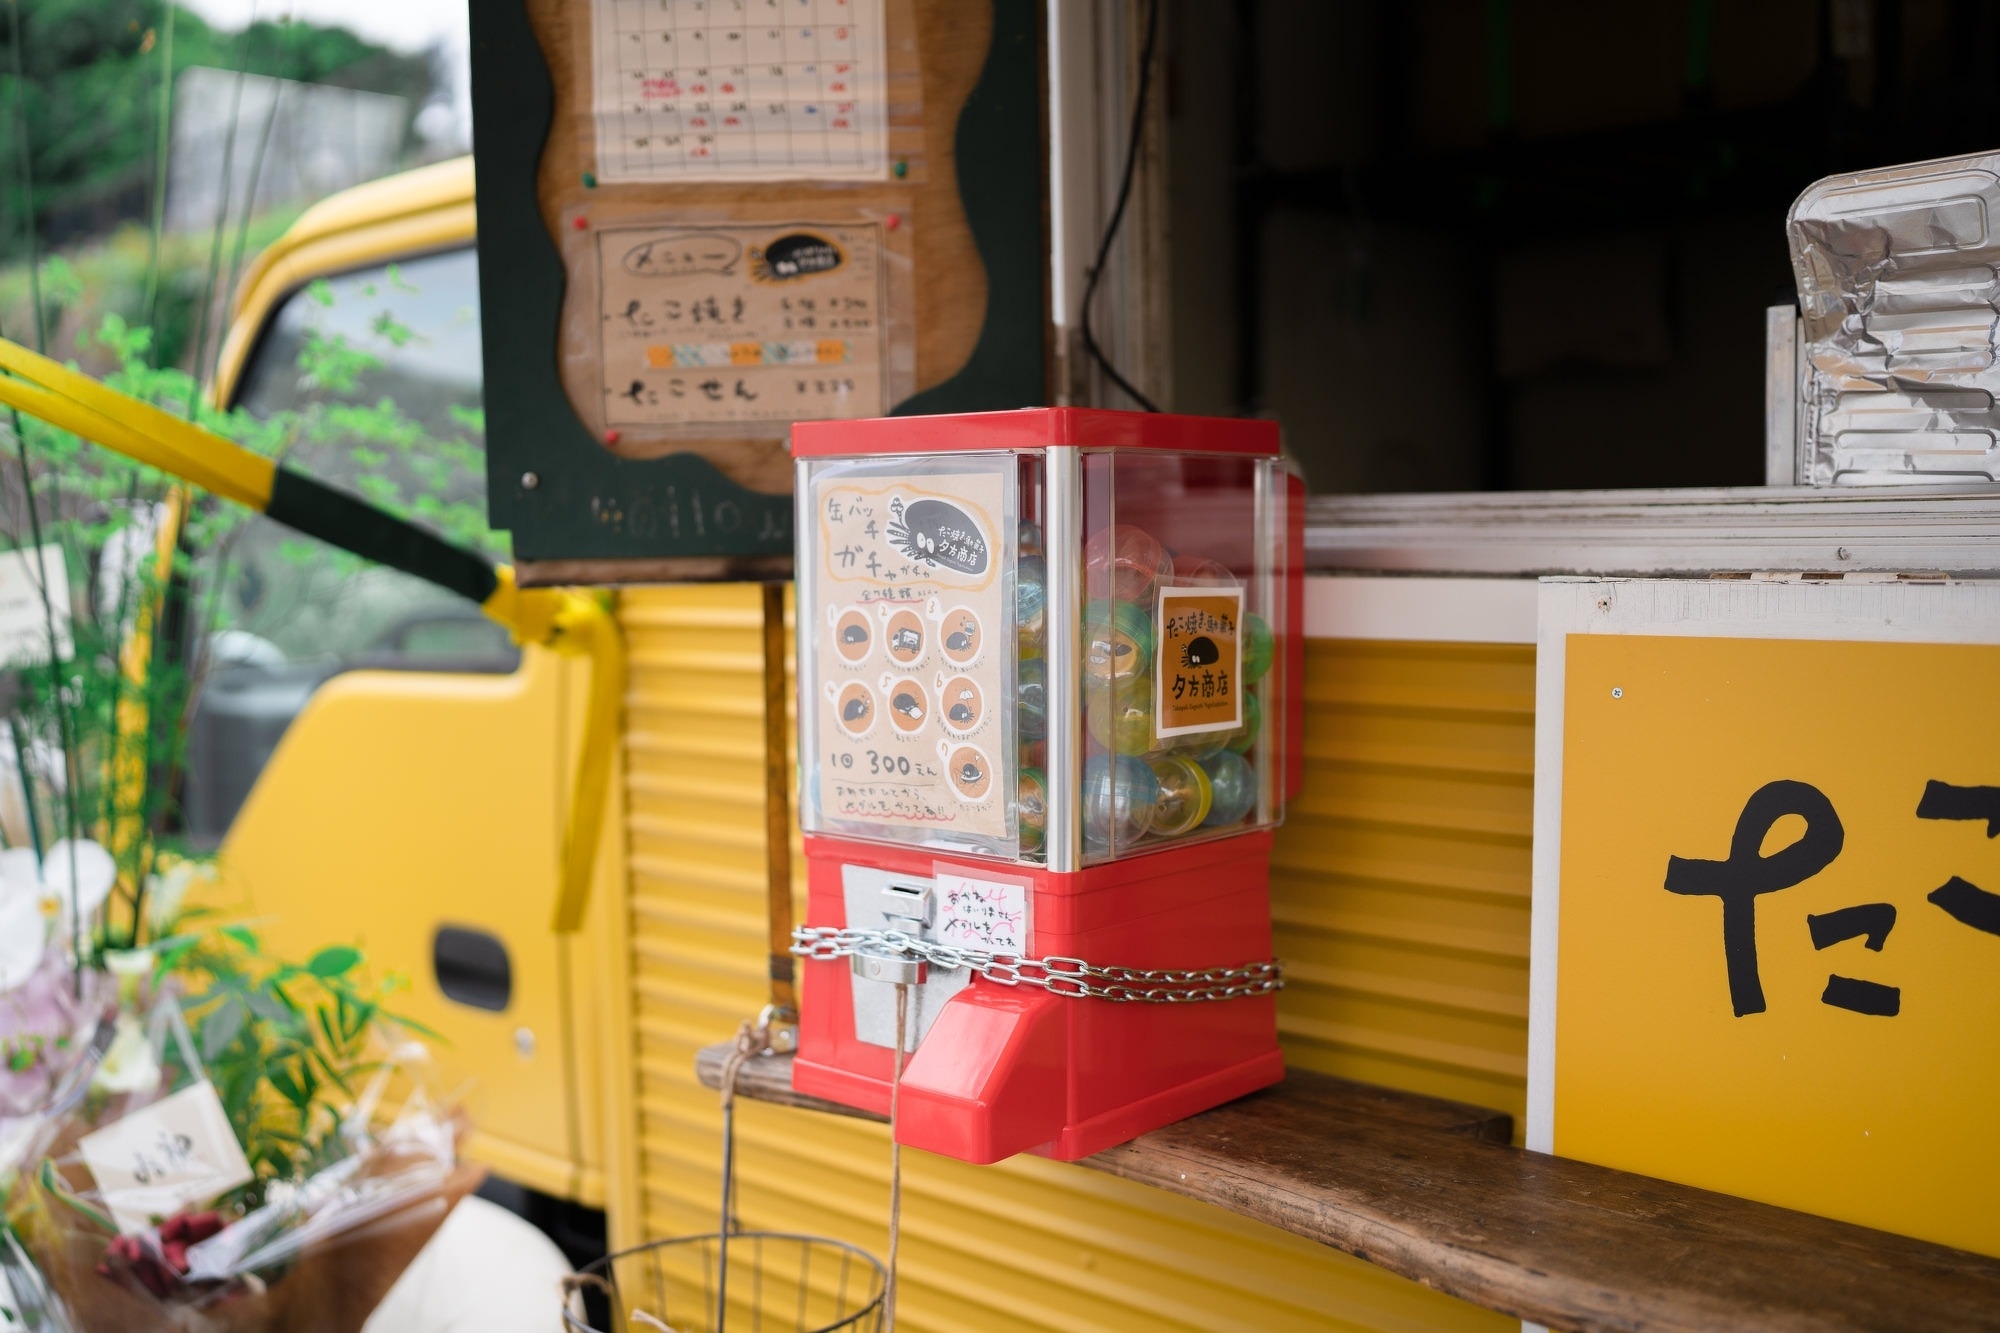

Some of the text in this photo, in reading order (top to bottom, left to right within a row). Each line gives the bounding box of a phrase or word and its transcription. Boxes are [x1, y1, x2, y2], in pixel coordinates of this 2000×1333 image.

[939, 540, 978, 566] 夕方商店
[881, 606, 888, 617] 2
[929, 601, 937, 614] 3
[882, 676, 893, 688] 5
[936, 675, 943, 688] 6
[1172, 669, 1228, 700] 夕方商店
